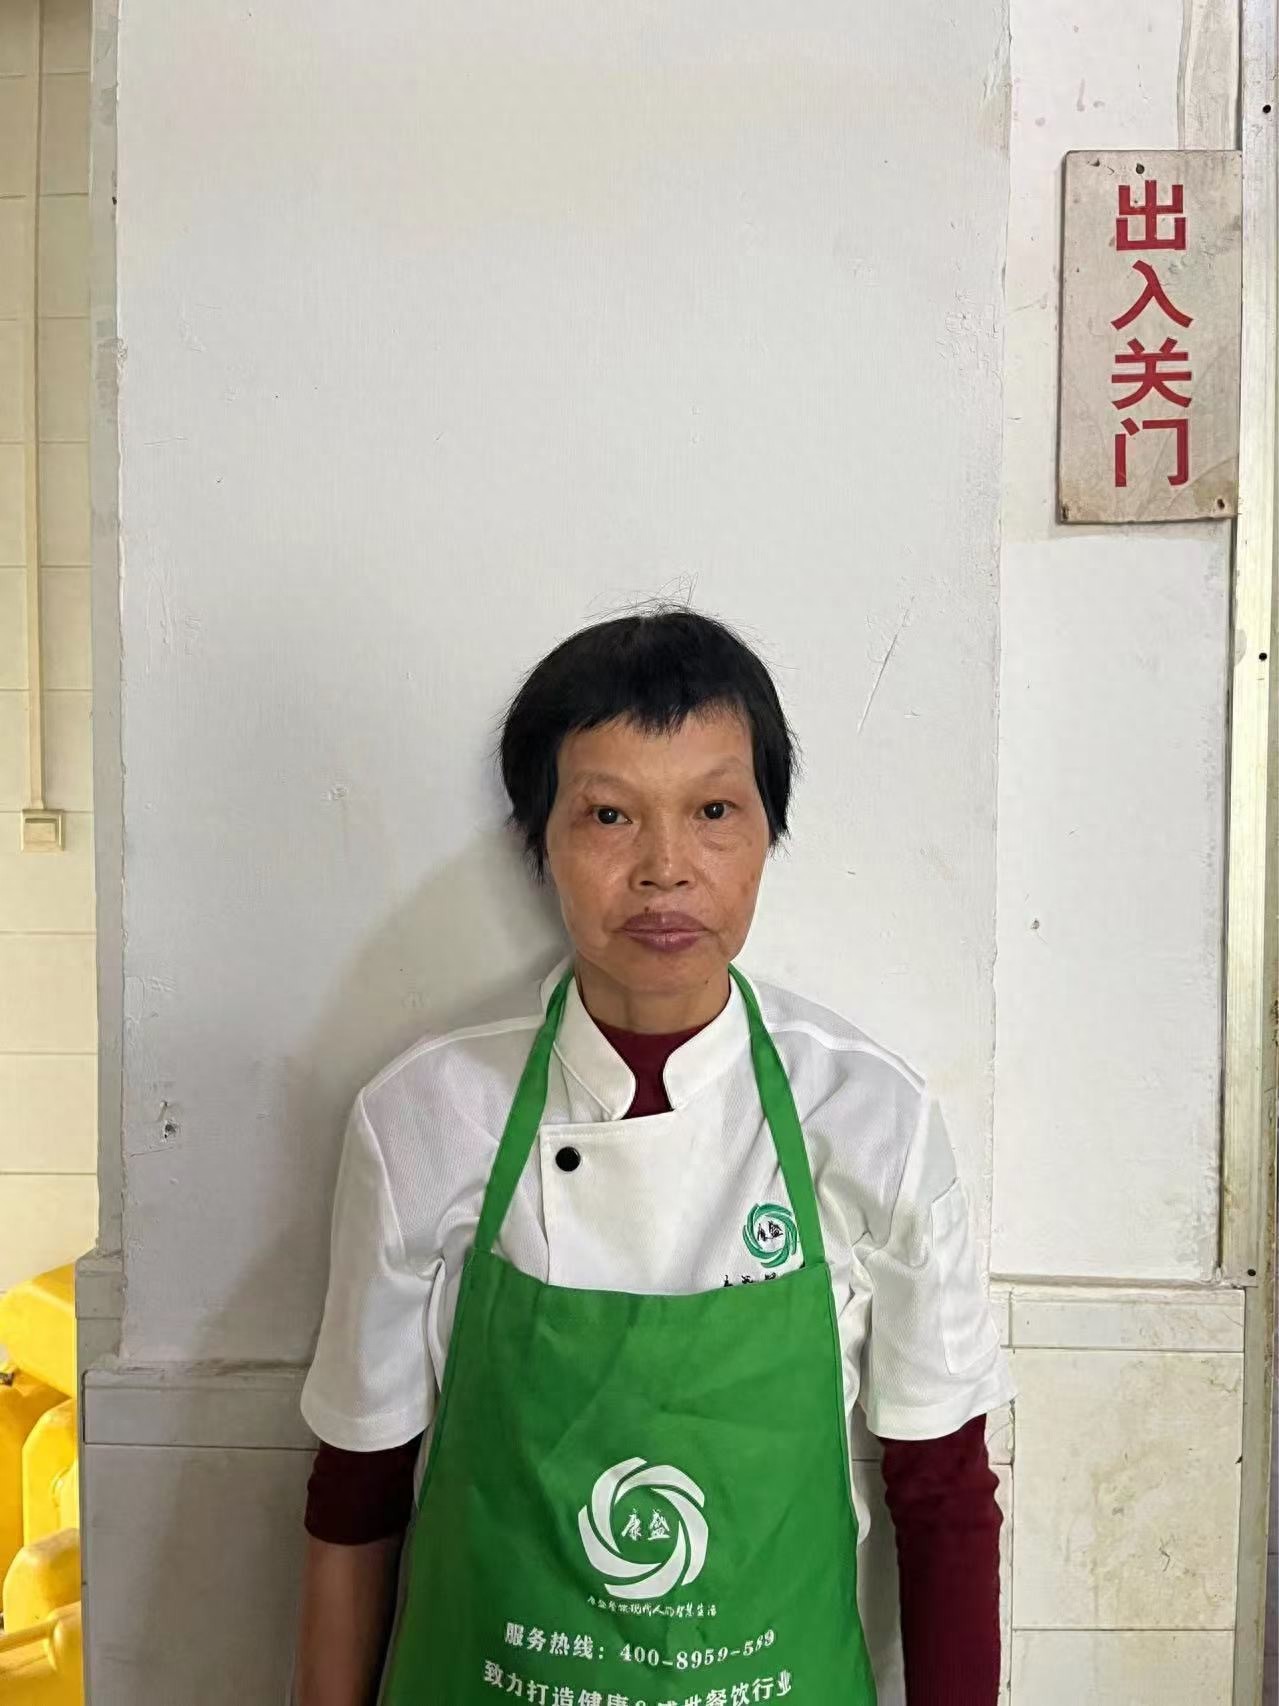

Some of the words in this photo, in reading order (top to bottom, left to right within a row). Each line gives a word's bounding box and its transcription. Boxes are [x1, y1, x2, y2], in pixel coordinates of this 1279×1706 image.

[1111, 179, 1193, 487] 出入关门
[621, 1507, 671, 1541] 康盛
